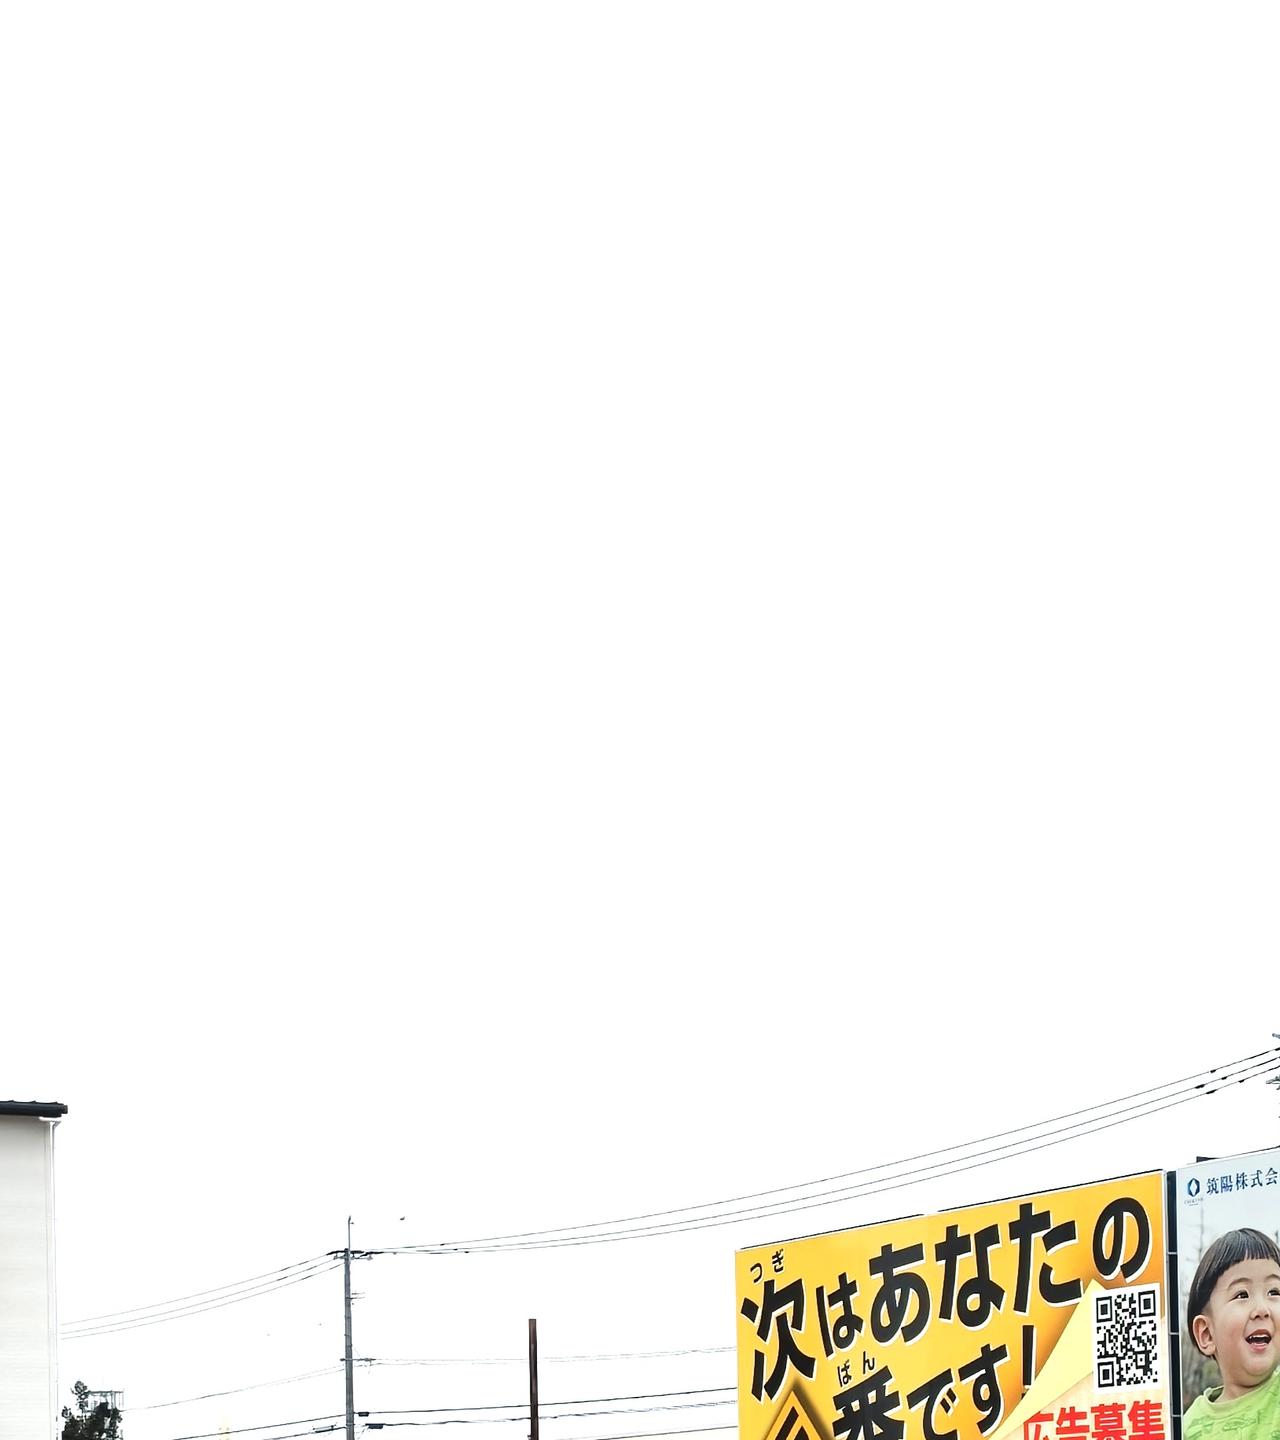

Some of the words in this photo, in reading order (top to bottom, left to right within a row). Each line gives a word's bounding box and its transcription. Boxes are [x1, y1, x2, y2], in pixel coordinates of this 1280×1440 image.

[750, 1248, 784, 1284] つぎ
[740, 1196, 1150, 1402] 次はあなたの
[837, 1351, 875, 1388] ばん
